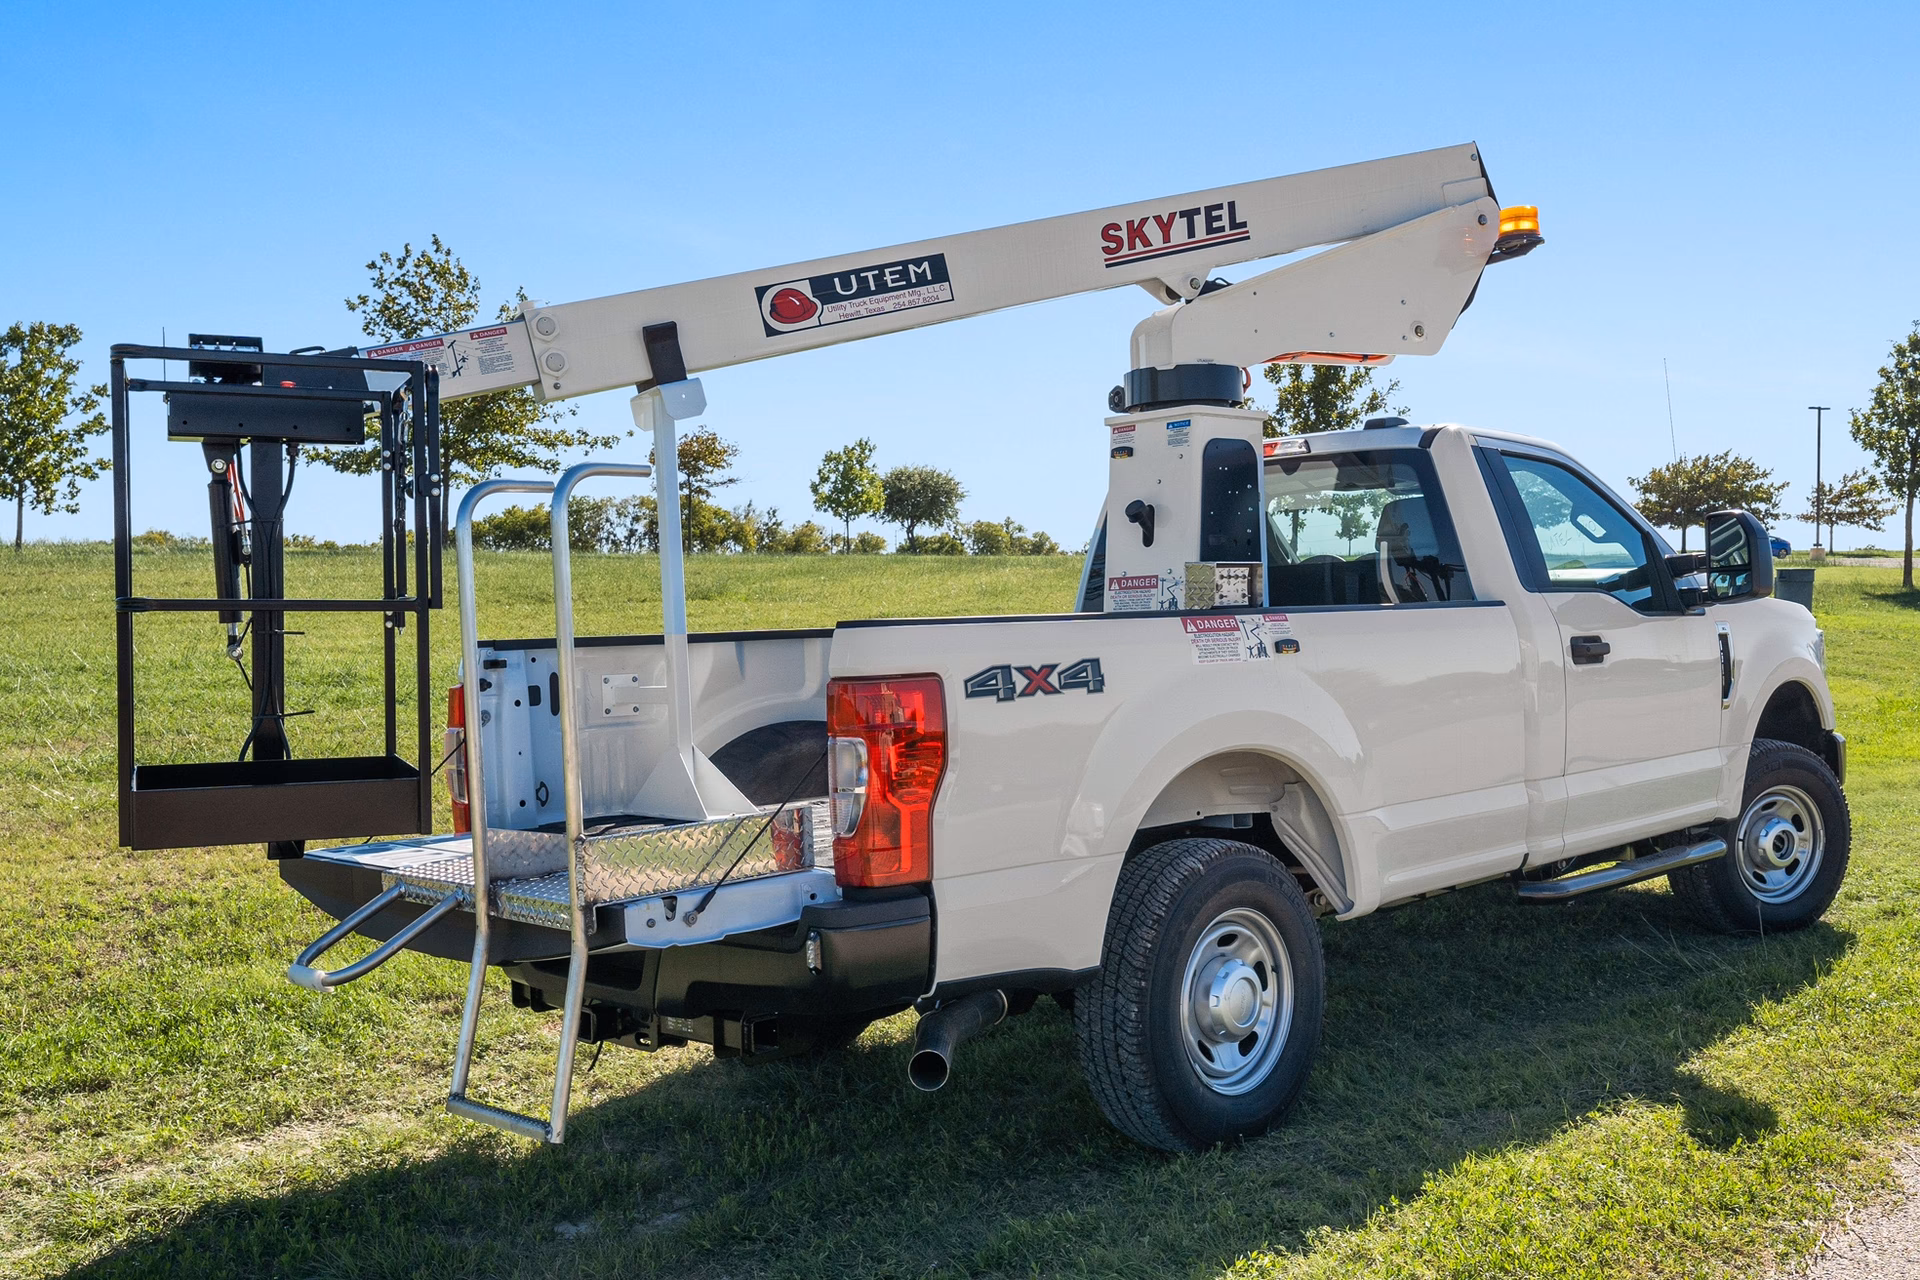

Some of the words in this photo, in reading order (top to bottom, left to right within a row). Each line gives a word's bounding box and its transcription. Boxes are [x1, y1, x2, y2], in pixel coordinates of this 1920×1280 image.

[1100, 200, 1248, 255] SKYTEL
[833, 260, 932, 295] UTEM
[826, 304, 846, 312] Utility
[848, 300, 867, 308] Truck
[868, 292, 906, 305] Equipment
[926, 284, 946, 294] L.L.C.
[864, 306, 885, 315] Texas
[892, 295, 939, 308] 254.857.8204
[480, 329, 505, 337] DANGER
[416, 340, 442, 349] DANGER
[376, 346, 403, 355] DANGER
[1121, 578, 1157, 587] DANGER
[1196, 619, 1237, 629] DANGER
